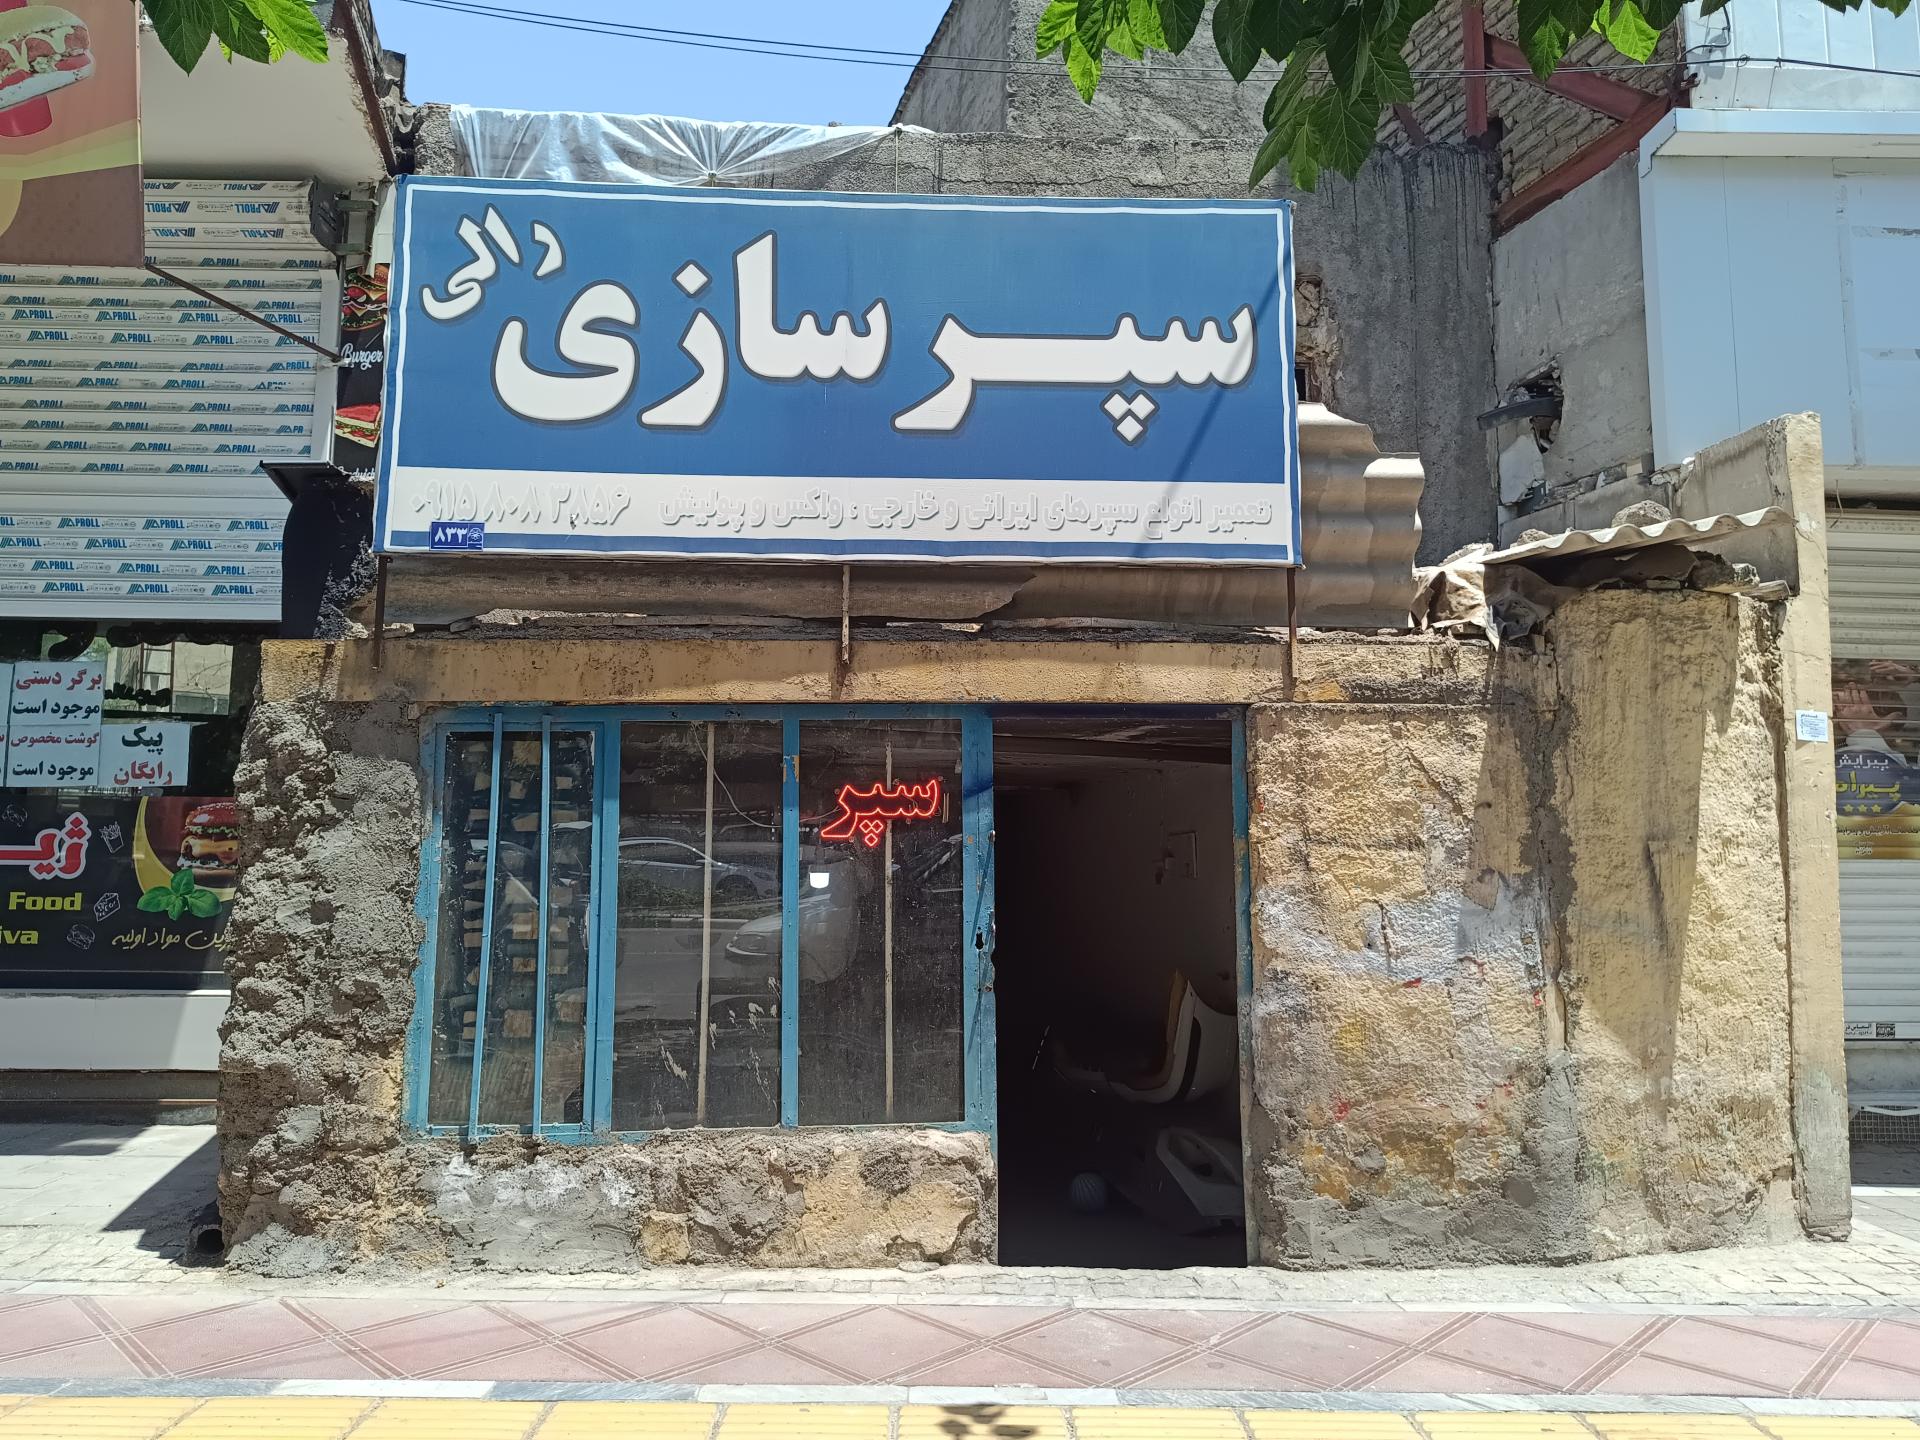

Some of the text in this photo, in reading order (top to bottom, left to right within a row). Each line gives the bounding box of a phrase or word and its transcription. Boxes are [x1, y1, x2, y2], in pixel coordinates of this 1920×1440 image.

[492, 230, 1257, 445] سپر سازی
[410, 479, 631, 526] ۰۹۱۵ ۸۰۸ ۳۸۵۶
[658, 486, 745, 533] پولیش
[770, 486, 844, 528] واکس
[864, 489, 939, 528] خارجی
[963, 492, 1038, 531] ایرانی
[1142, 495, 1202, 540] انواع
[1207, 499, 1272, 533] تعمیر
[434, 527, 468, 544] ۸۳۳
[16, 670, 62, 690] دستی
[12, 698, 100, 719] موجود است
[10, 732, 62, 747] مخصوص
[65, 731, 99, 747] گوشت
[121, 726, 164, 756] پیک
[12, 760, 94, 781] موجود است
[113, 761, 173, 786] رایگان
[820, 780, 939, 848] سپر
[8, 891, 82, 911] Food
